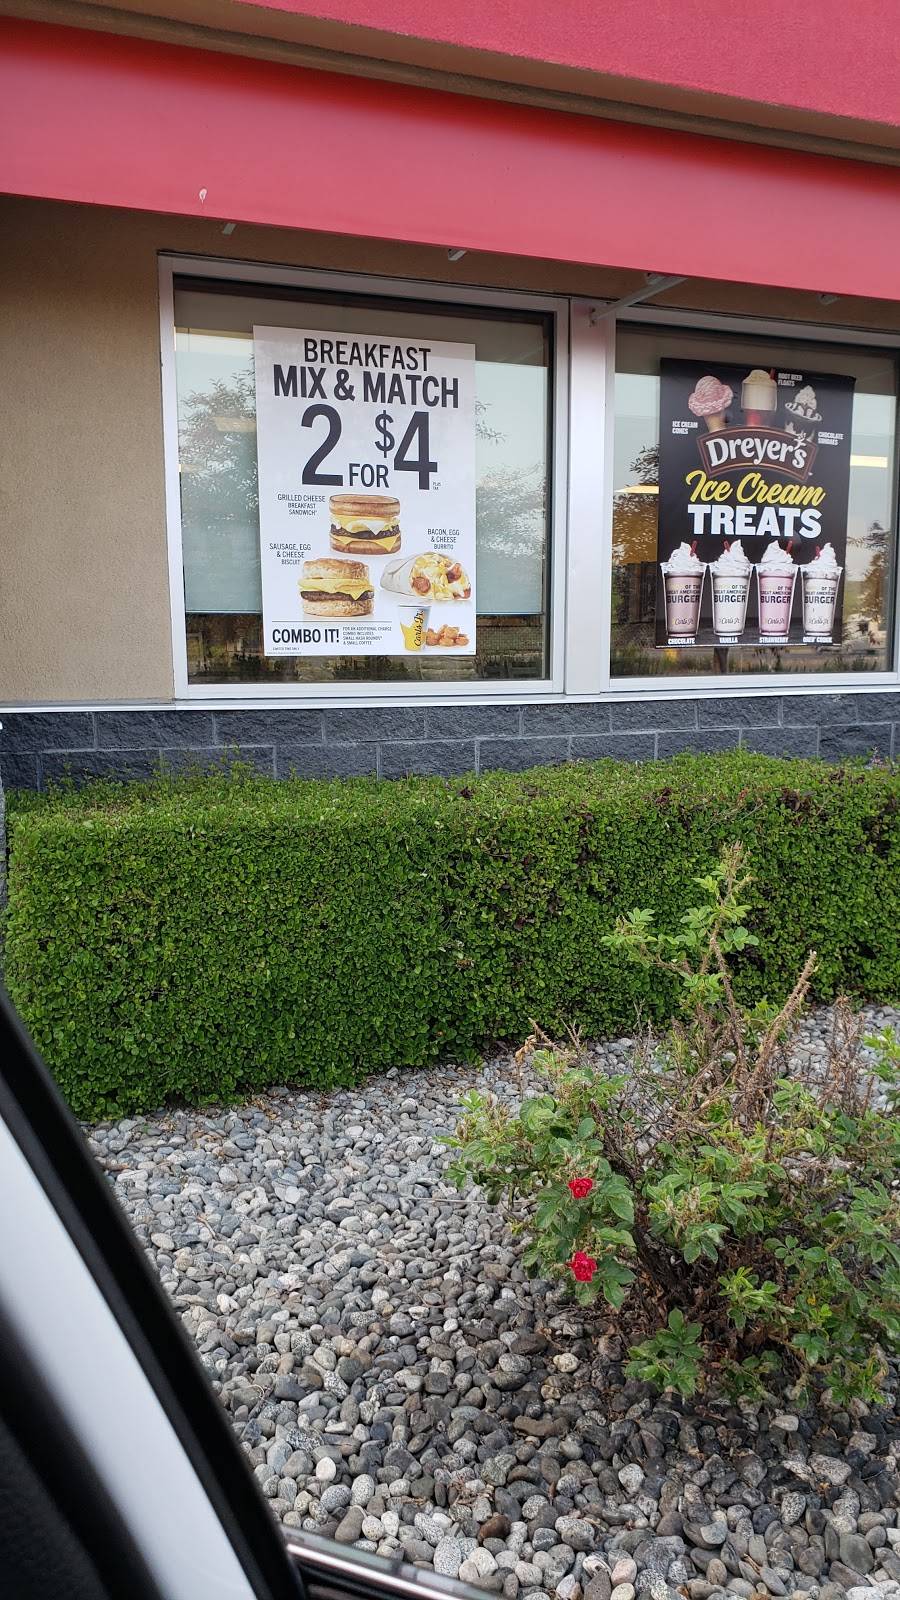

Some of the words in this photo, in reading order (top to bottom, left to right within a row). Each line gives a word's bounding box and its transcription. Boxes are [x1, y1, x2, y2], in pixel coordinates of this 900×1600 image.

[304, 338, 431, 371] BREAKFAST
[274, 364, 327, 399] MIX
[334, 369, 355, 402] &
[363, 371, 459, 408] MATCH
[301, 404, 344, 486] 2
[349, 463, 389, 488] FOR
[375, 410, 437, 490] $4
[706, 435, 807, 468] Dreyer's
[686, 470, 733, 502] Ice
[736, 472, 826, 506] Cream
[428, 528, 447, 536] BACON,
[688, 504, 822, 538] TREATS
[269, 543, 298, 551] SAUSAGE,
[667, 595, 700, 603] BURGER
[714, 595, 746, 603] BURGER
[272, 628, 320, 643] COMBO
[324, 628, 340, 643] IT!
